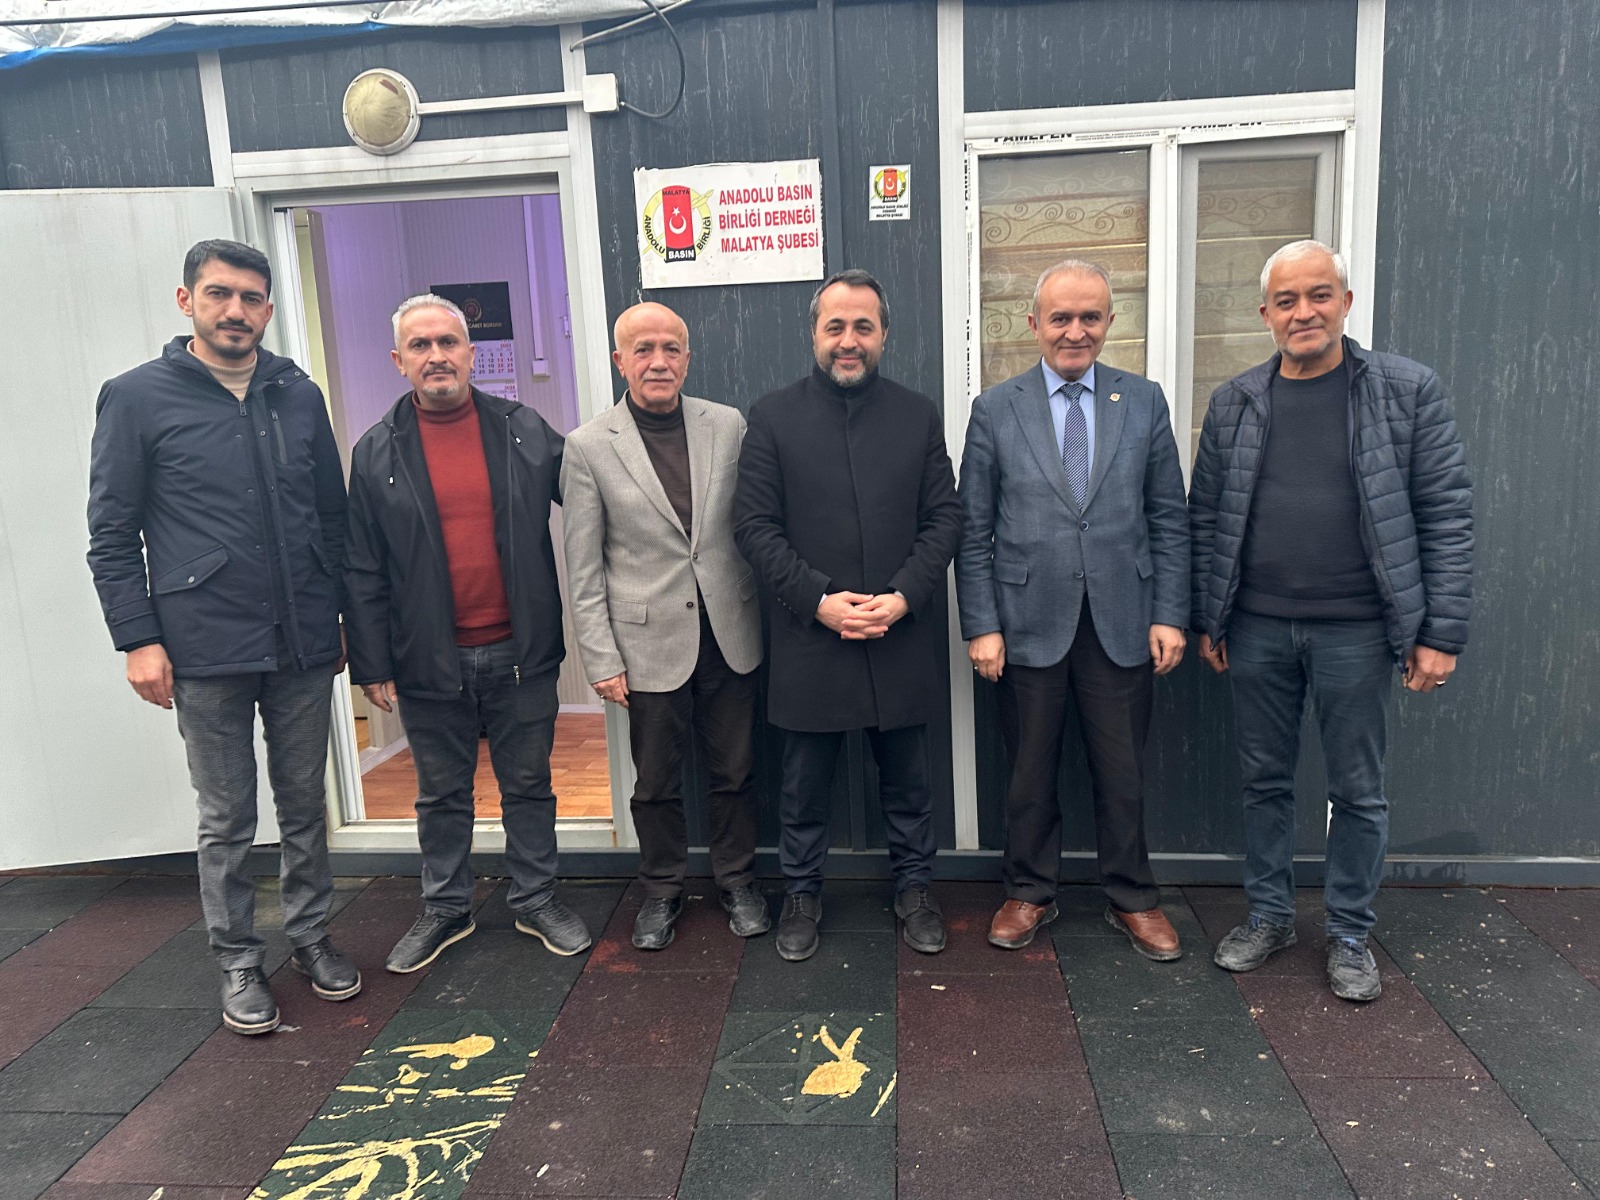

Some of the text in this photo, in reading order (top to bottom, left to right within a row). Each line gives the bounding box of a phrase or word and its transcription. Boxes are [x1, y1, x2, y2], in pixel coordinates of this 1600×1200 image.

[720, 184, 812, 205] ANADOLU BASIN
[719, 204, 815, 229] BİRLİĞİ DERNEĞİ
[644, 214, 665, 254] ANADOLU
[721, 228, 819, 254] MALATYA ŞUBESİ
[668, 250, 694, 259] BASIN
